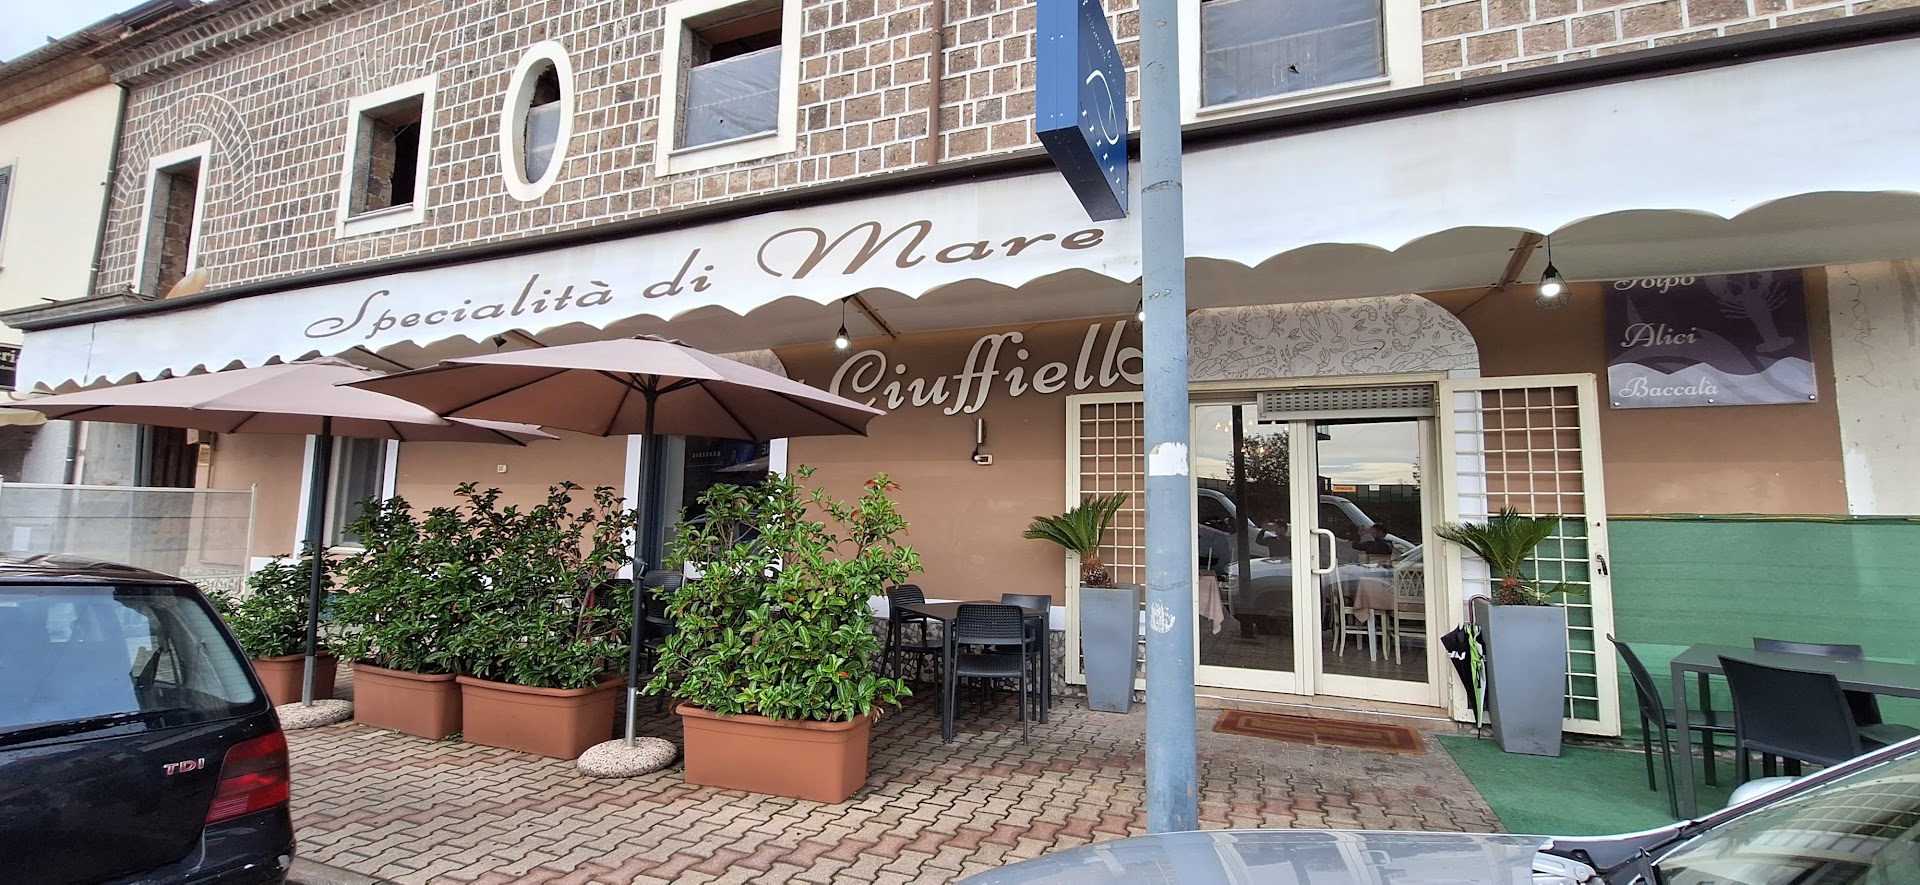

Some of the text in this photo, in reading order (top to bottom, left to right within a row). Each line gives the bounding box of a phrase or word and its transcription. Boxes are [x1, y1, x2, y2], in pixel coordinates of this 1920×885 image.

[304, 220, 1105, 340] Specialità di Mare
[1620, 322, 1697, 348] Alici
[1618, 375, 1719, 398] Baccalà
[163, 757, 205, 776] TDI
